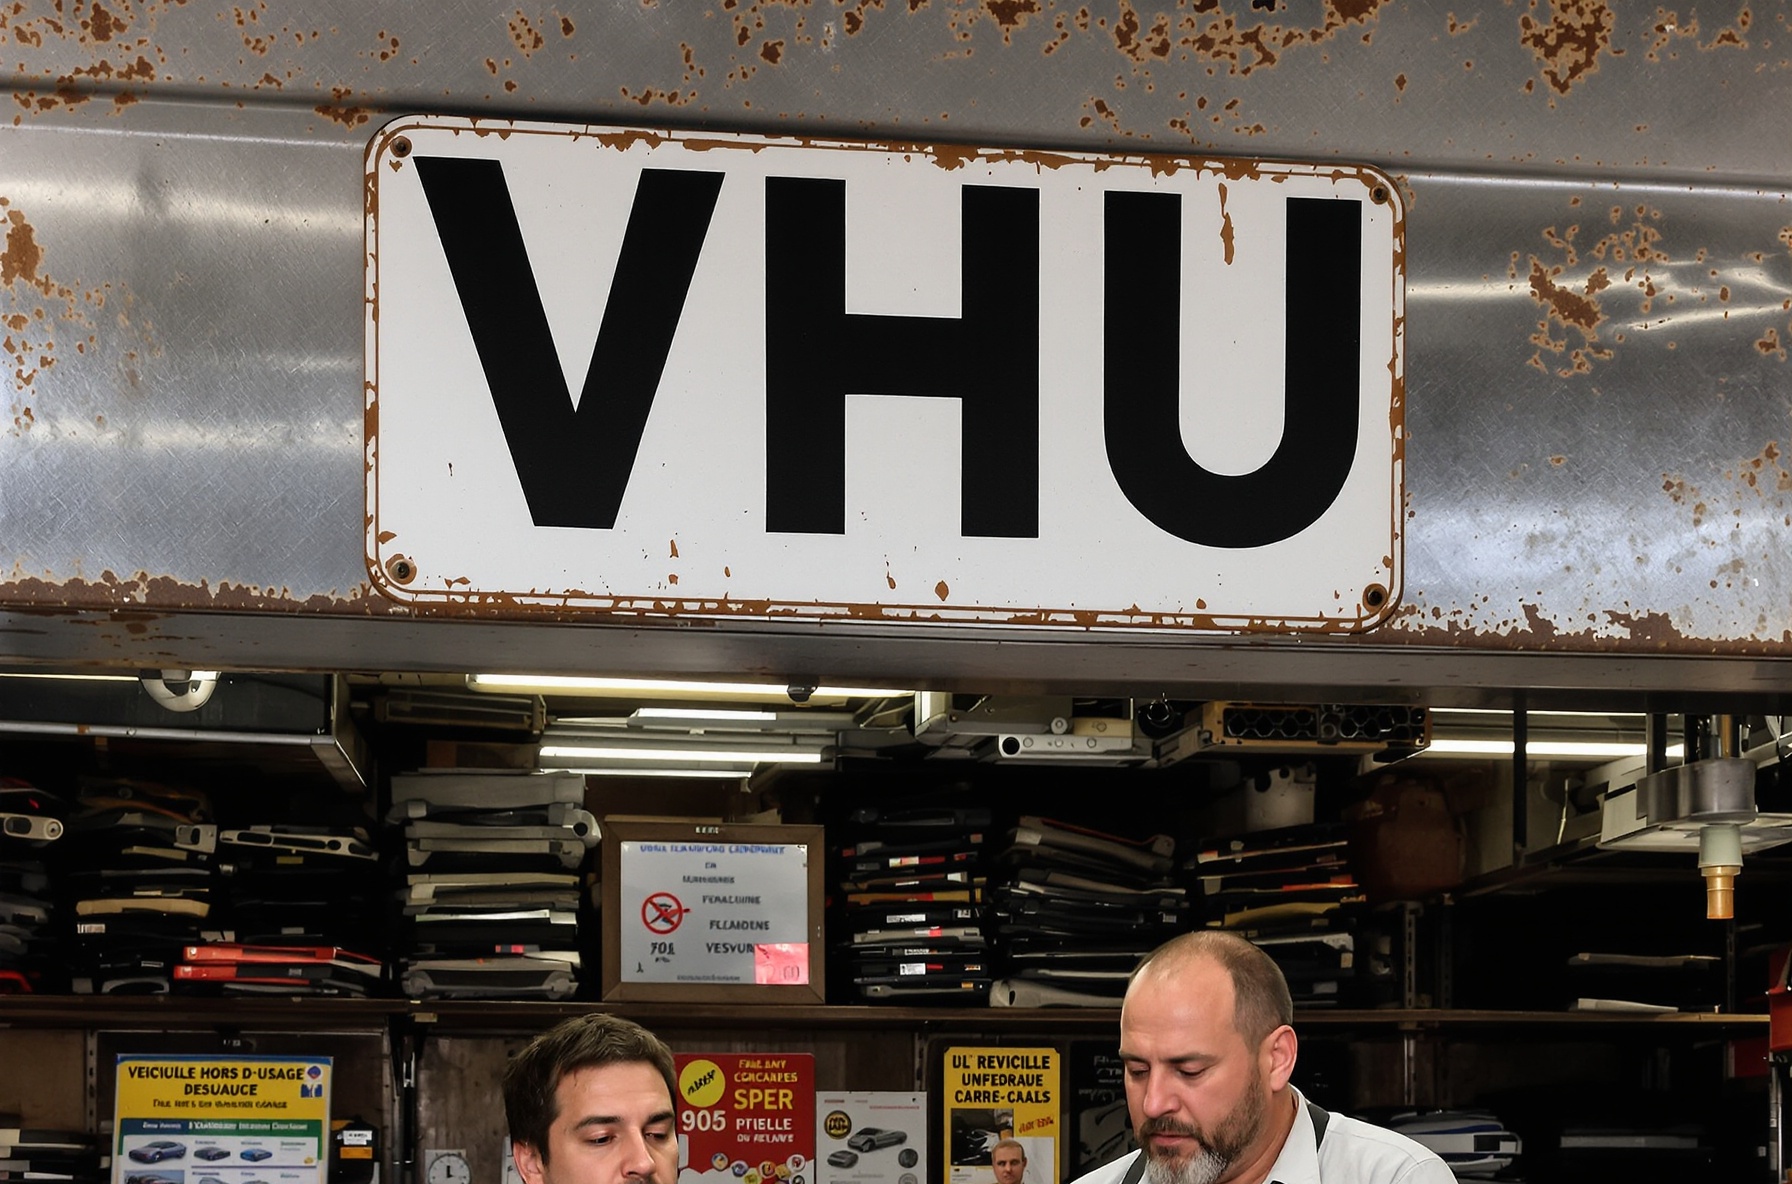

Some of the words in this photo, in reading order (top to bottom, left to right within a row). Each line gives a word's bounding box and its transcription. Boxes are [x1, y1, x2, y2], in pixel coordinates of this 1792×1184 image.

[413, 156, 1362, 548] VHU
[200, 1067, 238, 1080] HORS
[733, 1089, 793, 1110] SPER
[682, 1110, 726, 1131] 905
